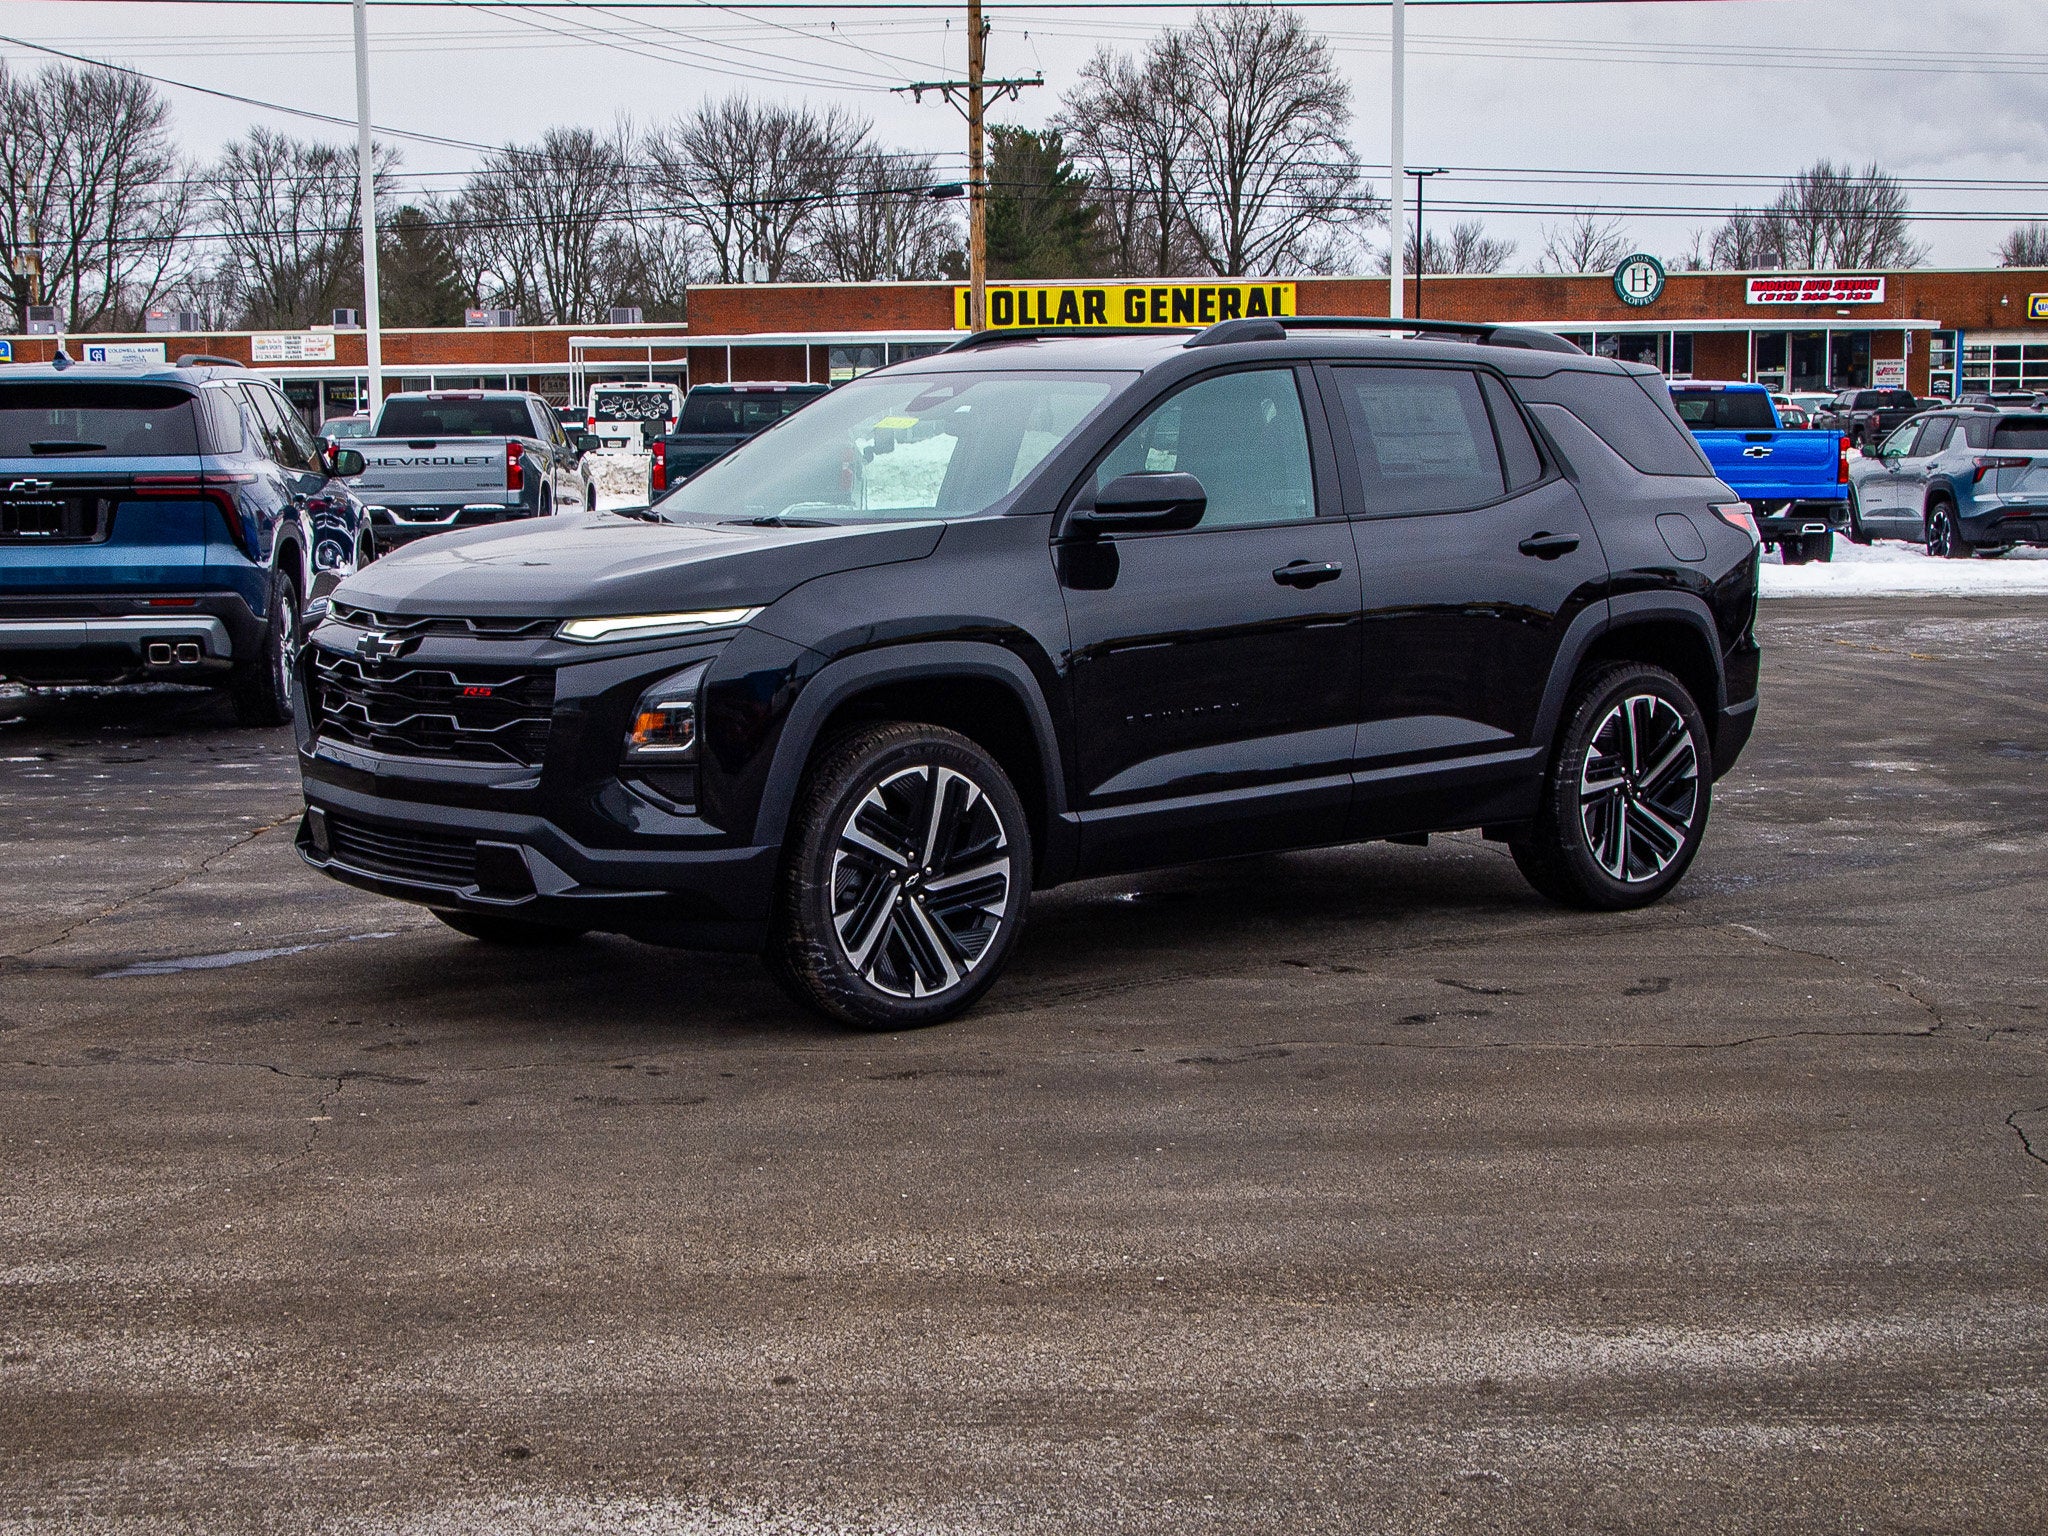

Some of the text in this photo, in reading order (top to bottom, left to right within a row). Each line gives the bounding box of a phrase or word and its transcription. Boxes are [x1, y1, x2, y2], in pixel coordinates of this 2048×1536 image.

[1751, 279, 1880, 291] MADISON AUTO SERVICE
[1124, 287, 1288, 324] GENERAL
[1623, 294, 1655, 306] COFFEE
[366, 456, 494, 466] HEVROLET
[463, 687, 492, 697] RS
